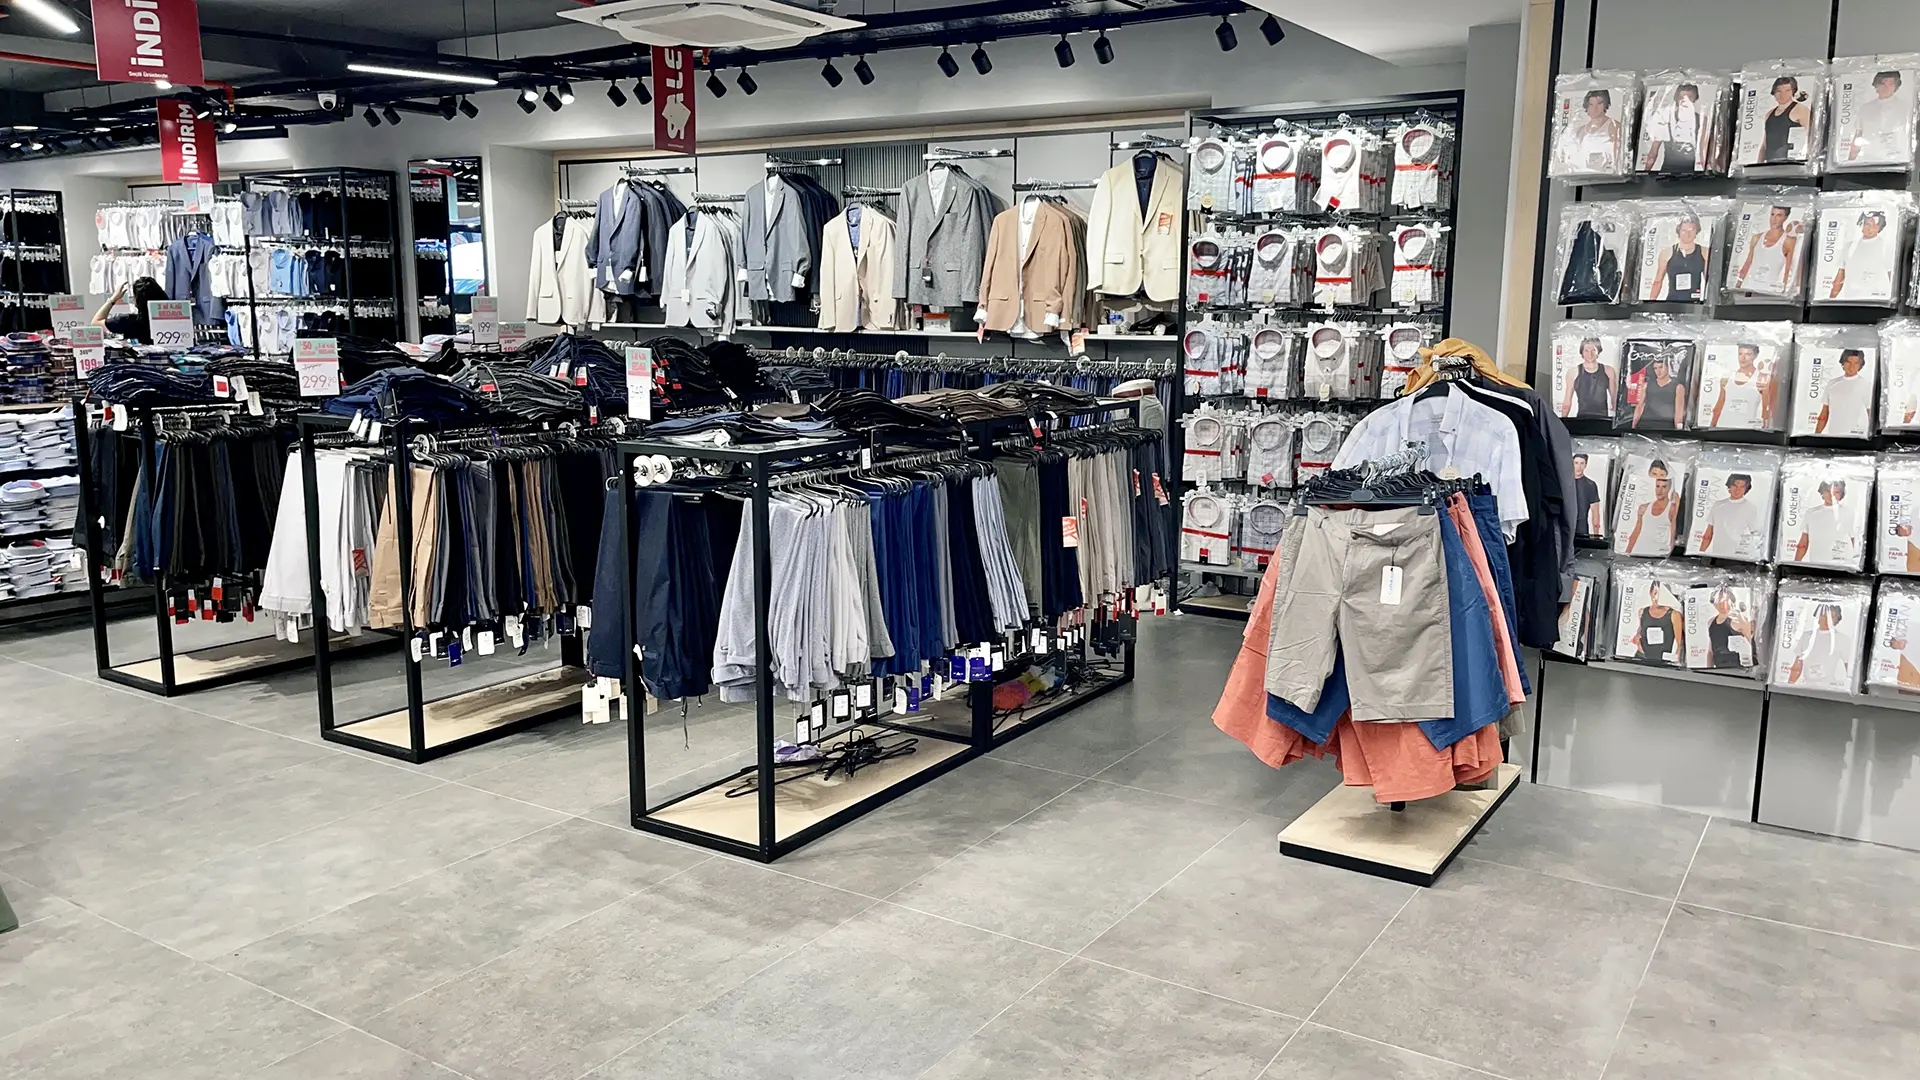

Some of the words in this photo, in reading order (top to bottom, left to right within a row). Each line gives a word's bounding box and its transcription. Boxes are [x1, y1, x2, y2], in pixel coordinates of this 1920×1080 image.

[176, 104, 199, 175] İNDİRİM
[1809, 364, 1822, 399] GUNERI
[1894, 364, 1904, 388] GUNE
[1622, 489, 1635, 521] GUNERI
[1696, 486, 1708, 518] GUNERI
[1622, 594, 1634, 624] GUNERI
[1689, 604, 1697, 635] GUNERI
